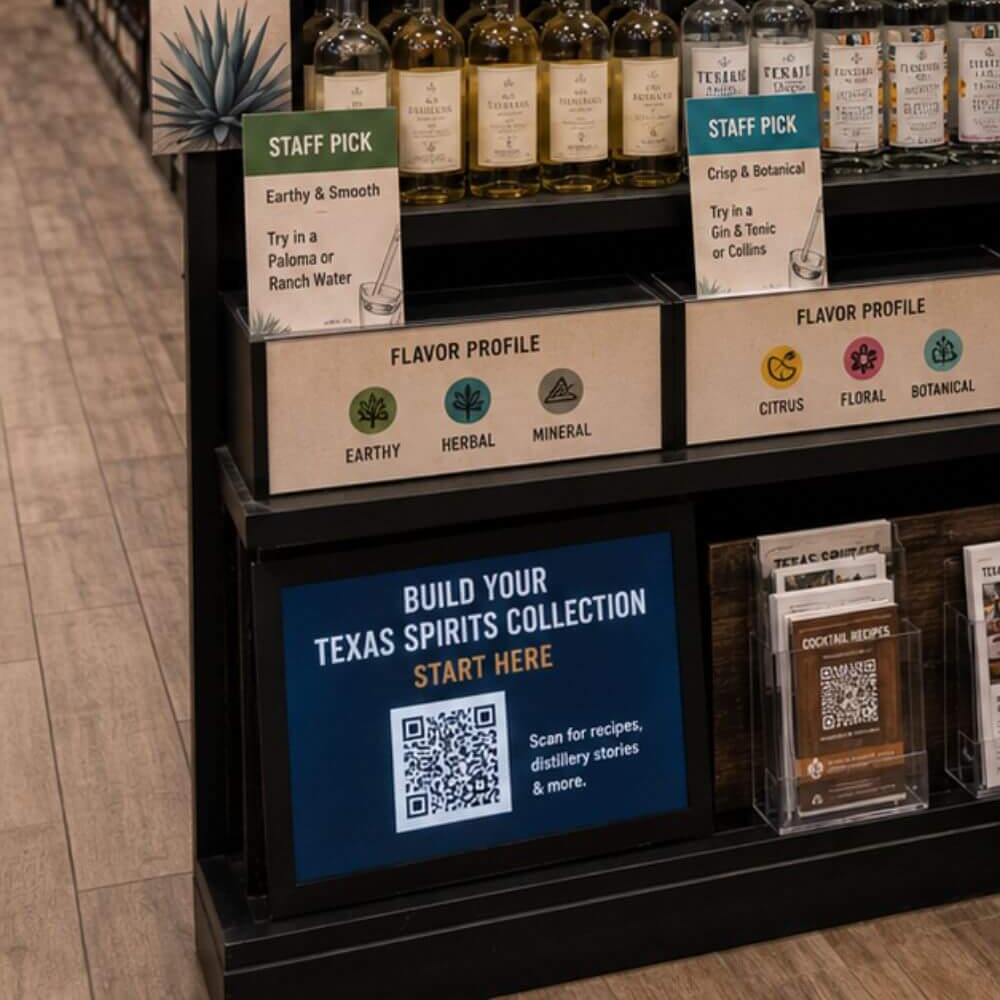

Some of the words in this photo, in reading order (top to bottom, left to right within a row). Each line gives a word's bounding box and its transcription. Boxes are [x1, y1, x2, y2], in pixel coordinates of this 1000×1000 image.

[708, 117, 755, 138] STAFF
[761, 115, 797, 135] PICK
[269, 134, 324, 157] STAFF
[330, 131, 372, 153] PICK
[708, 166, 737, 182] Crisp
[741, 166, 749, 178] &
[754, 162, 805, 177] Botanical
[266, 189, 310, 205] Earthy
[315, 187, 324, 201] &
[329, 183, 380, 200] Smooth
[711, 206, 729, 221] Try
[732, 205, 743, 216] in
[746, 206, 752, 216] a
[267, 232, 289, 248] Try
[294, 231, 305, 244] in
[309, 232, 317, 243] a
[712, 225, 730, 239] Gin
[734, 225, 743, 237] &
[269, 253, 317, 268] Paloma
[320, 252, 334, 264] or
[713, 248, 725, 259] or
[729, 243, 767, 257] Collins
[269, 274, 309, 290] Ranch
[313, 272, 352, 287] Water
[797, 305, 856, 325] FLAVOR
[862, 298, 926, 319] PROFILE
[391, 343, 460, 366] FLAVOR
[467, 335, 541, 360] PROFILE
[760, 398, 804, 416] CITRUS
[841, 390, 886, 407] FLORAL
[912, 379, 976, 398] BOTANICAL
[345, 443, 401, 464] EARTHY
[442, 433, 495, 453] HERBAL
[532, 423, 592, 442] MINERAL
[403, 577, 475, 615] BUILD
[484, 566, 547, 601] YOUR
[315, 628, 395, 666] TEXAS
[404, 612, 499, 652] SPIRITS
[507, 588, 646, 636] COLLECTION
[414, 655, 486, 689] START
[494, 644, 553, 676] HERE
[529, 731, 563, 748] Scan
[567, 727, 586, 742] for
[590, 719, 644, 740] recipes,
[531, 749, 590, 773] distillery
[593, 741, 640, 761] stories
[532, 780, 544, 795] &
[547, 775, 586, 793] more.
